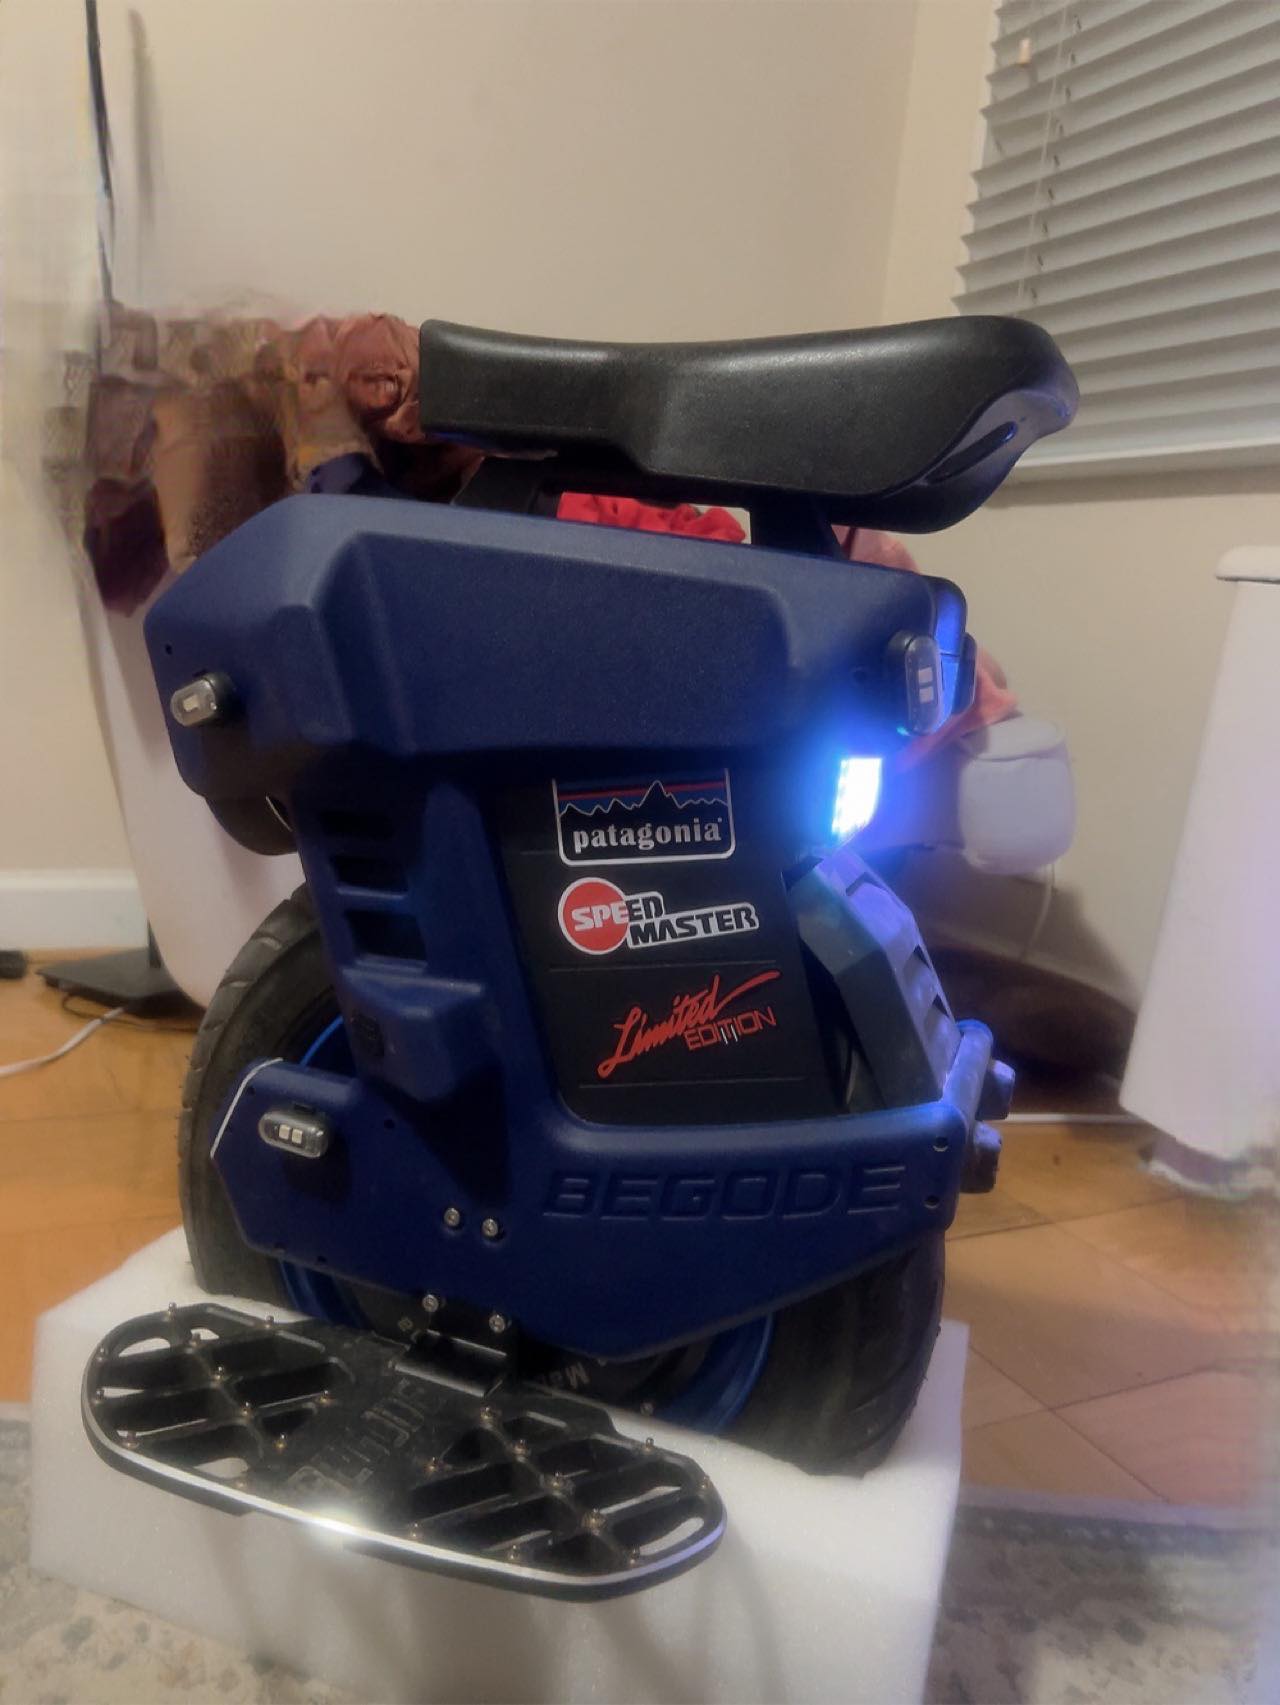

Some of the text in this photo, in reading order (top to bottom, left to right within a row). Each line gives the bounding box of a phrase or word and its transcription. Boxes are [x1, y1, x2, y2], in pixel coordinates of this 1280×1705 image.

[572, 818, 722, 854] patagonia
[571, 895, 664, 932] SPEED
[629, 906, 757, 946] MASTER
[596, 969, 781, 1078] Limited
[683, 1006, 777, 1051] EDITION
[541, 1164, 907, 1221] BEGODE
